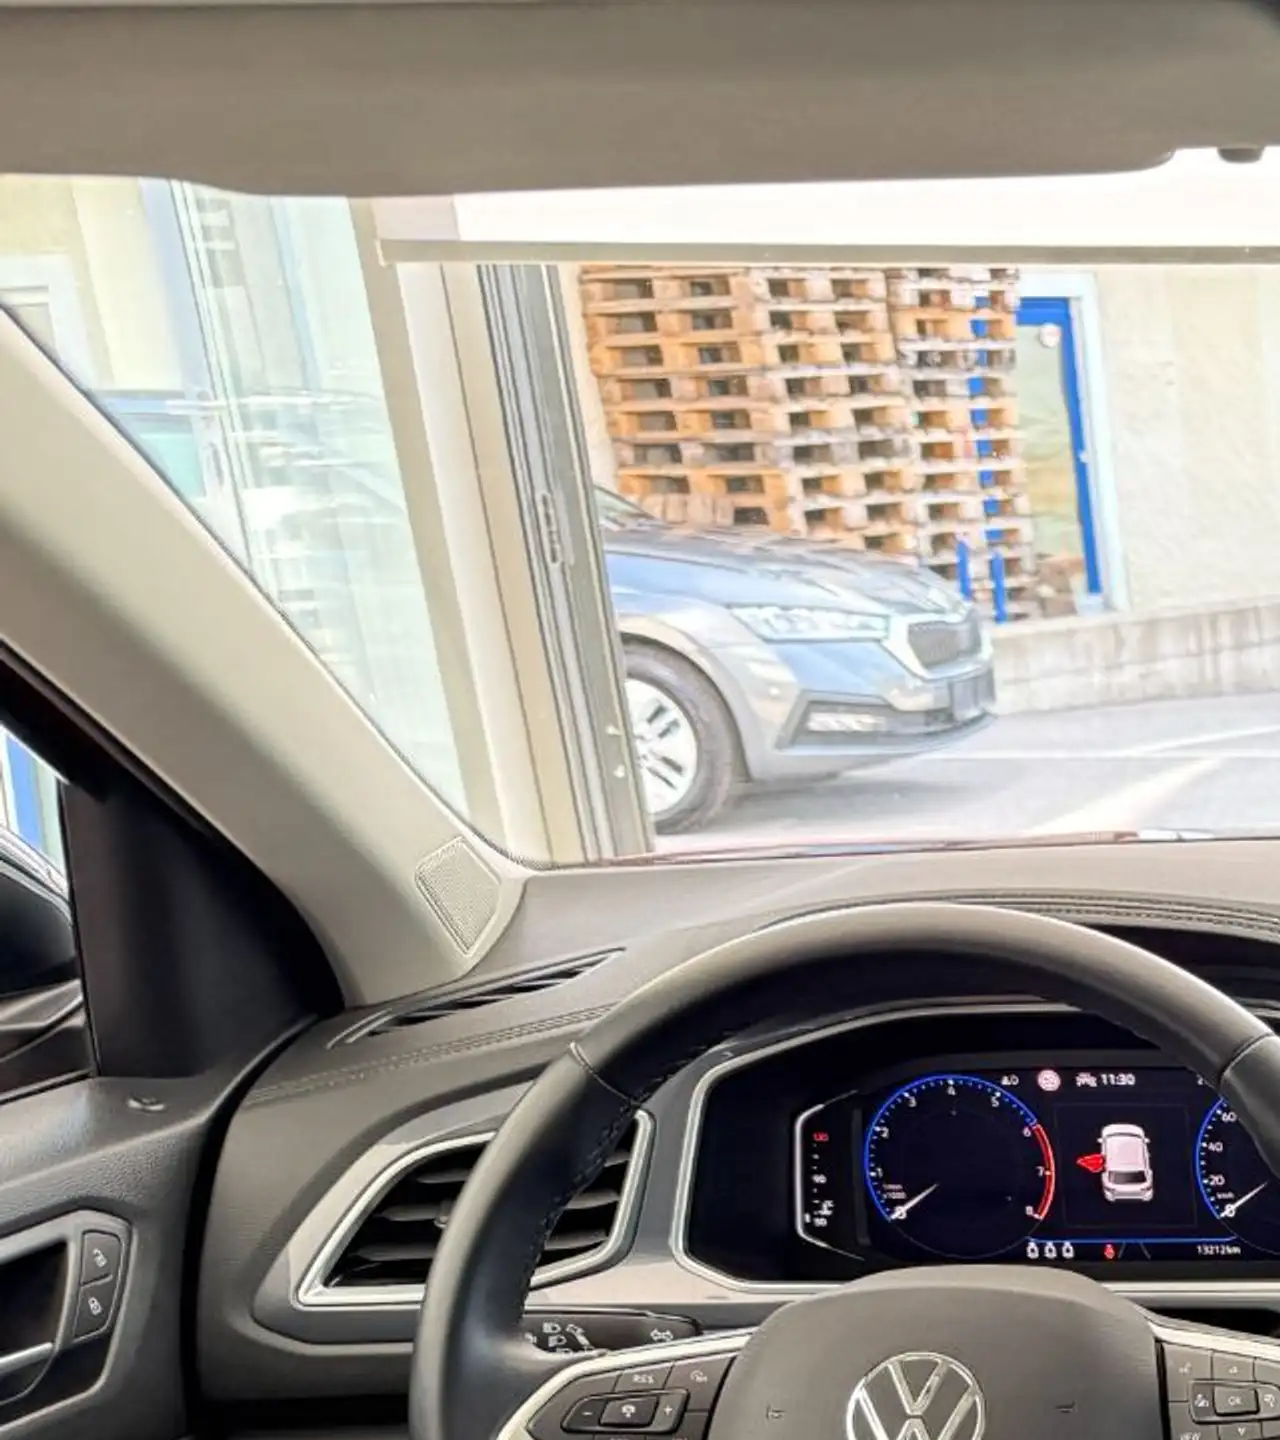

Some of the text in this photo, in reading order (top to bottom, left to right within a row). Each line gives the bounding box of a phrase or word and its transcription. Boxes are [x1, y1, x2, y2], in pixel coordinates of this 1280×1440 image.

[1100, 1073, 1136, 1086] 11:30
[947, 1085, 956, 1096] 4
[908, 1095, 918, 1107] 3
[990, 1097, 1001, 1108] 5
[1221, 1111, 1238, 1123] 60
[880, 1127, 890, 1139] 2
[1023, 1127, 1032, 1138] 6
[1207, 1141, 1224, 1153] 40
[1208, 1174, 1226, 1186] 20
[632, 1373, 654, 1385] RES
[1228, 1395, 1242, 1406] OK
